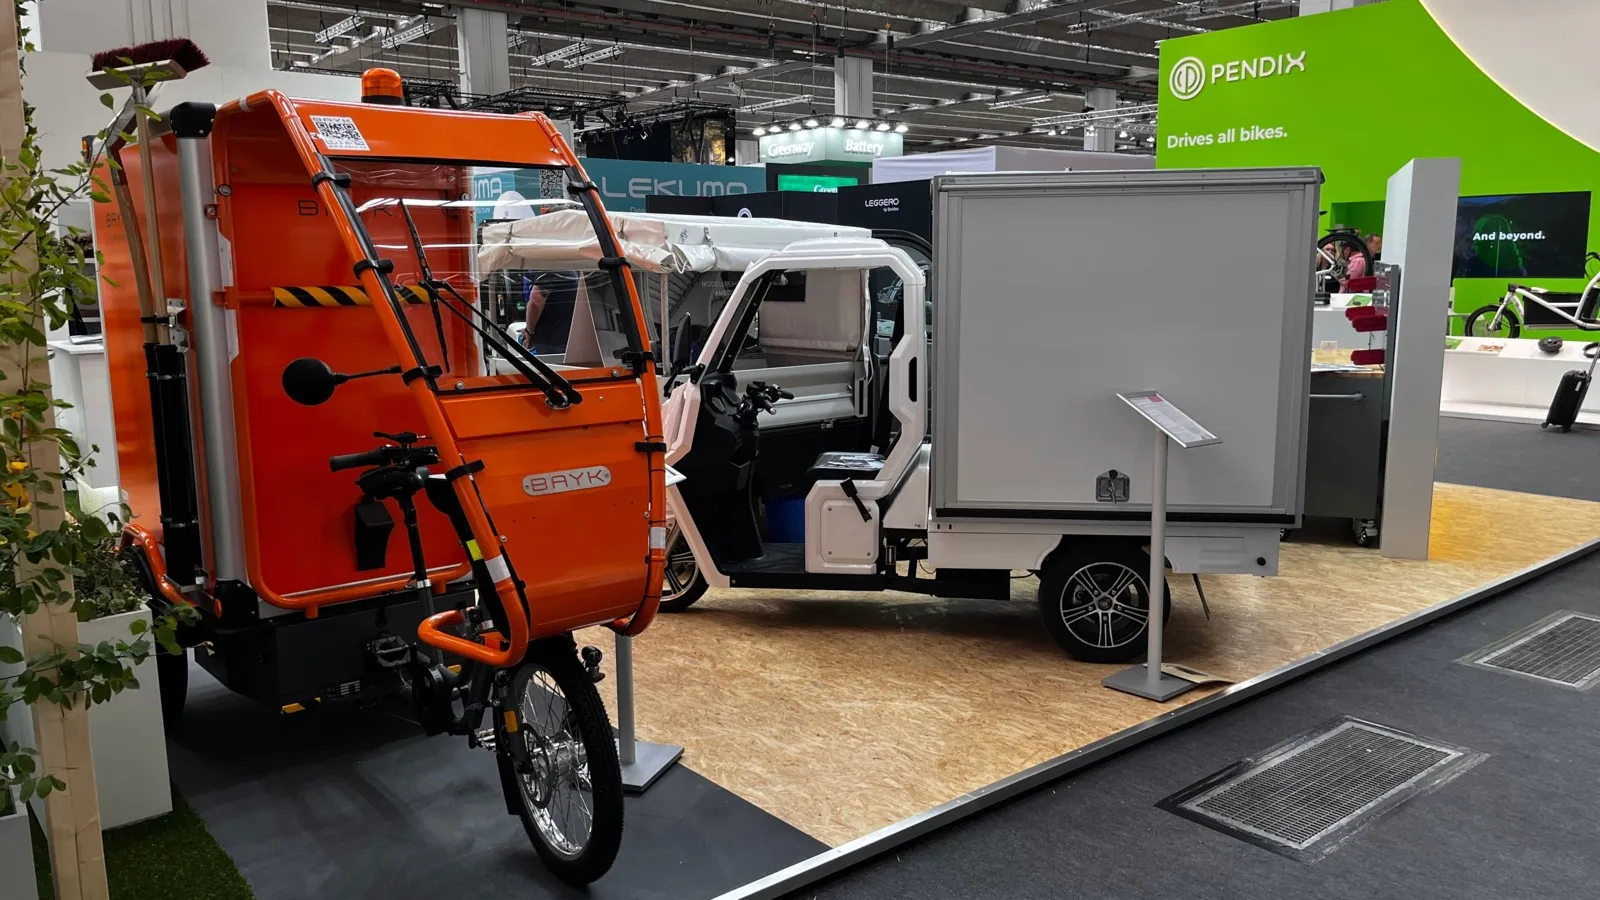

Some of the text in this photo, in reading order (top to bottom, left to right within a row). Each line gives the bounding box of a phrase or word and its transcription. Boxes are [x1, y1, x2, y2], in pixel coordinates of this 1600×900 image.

[1211, 50, 1306, 84] PENDIX
[1167, 125, 1288, 149] Drives all bikes.
[768, 142, 815, 157] Greenway
[845, 140, 885, 156] Battery
[864, 198, 900, 207] LEGGERO
[1472, 230, 1546, 242] And beyond.
[530, 469, 605, 492] BAYK
